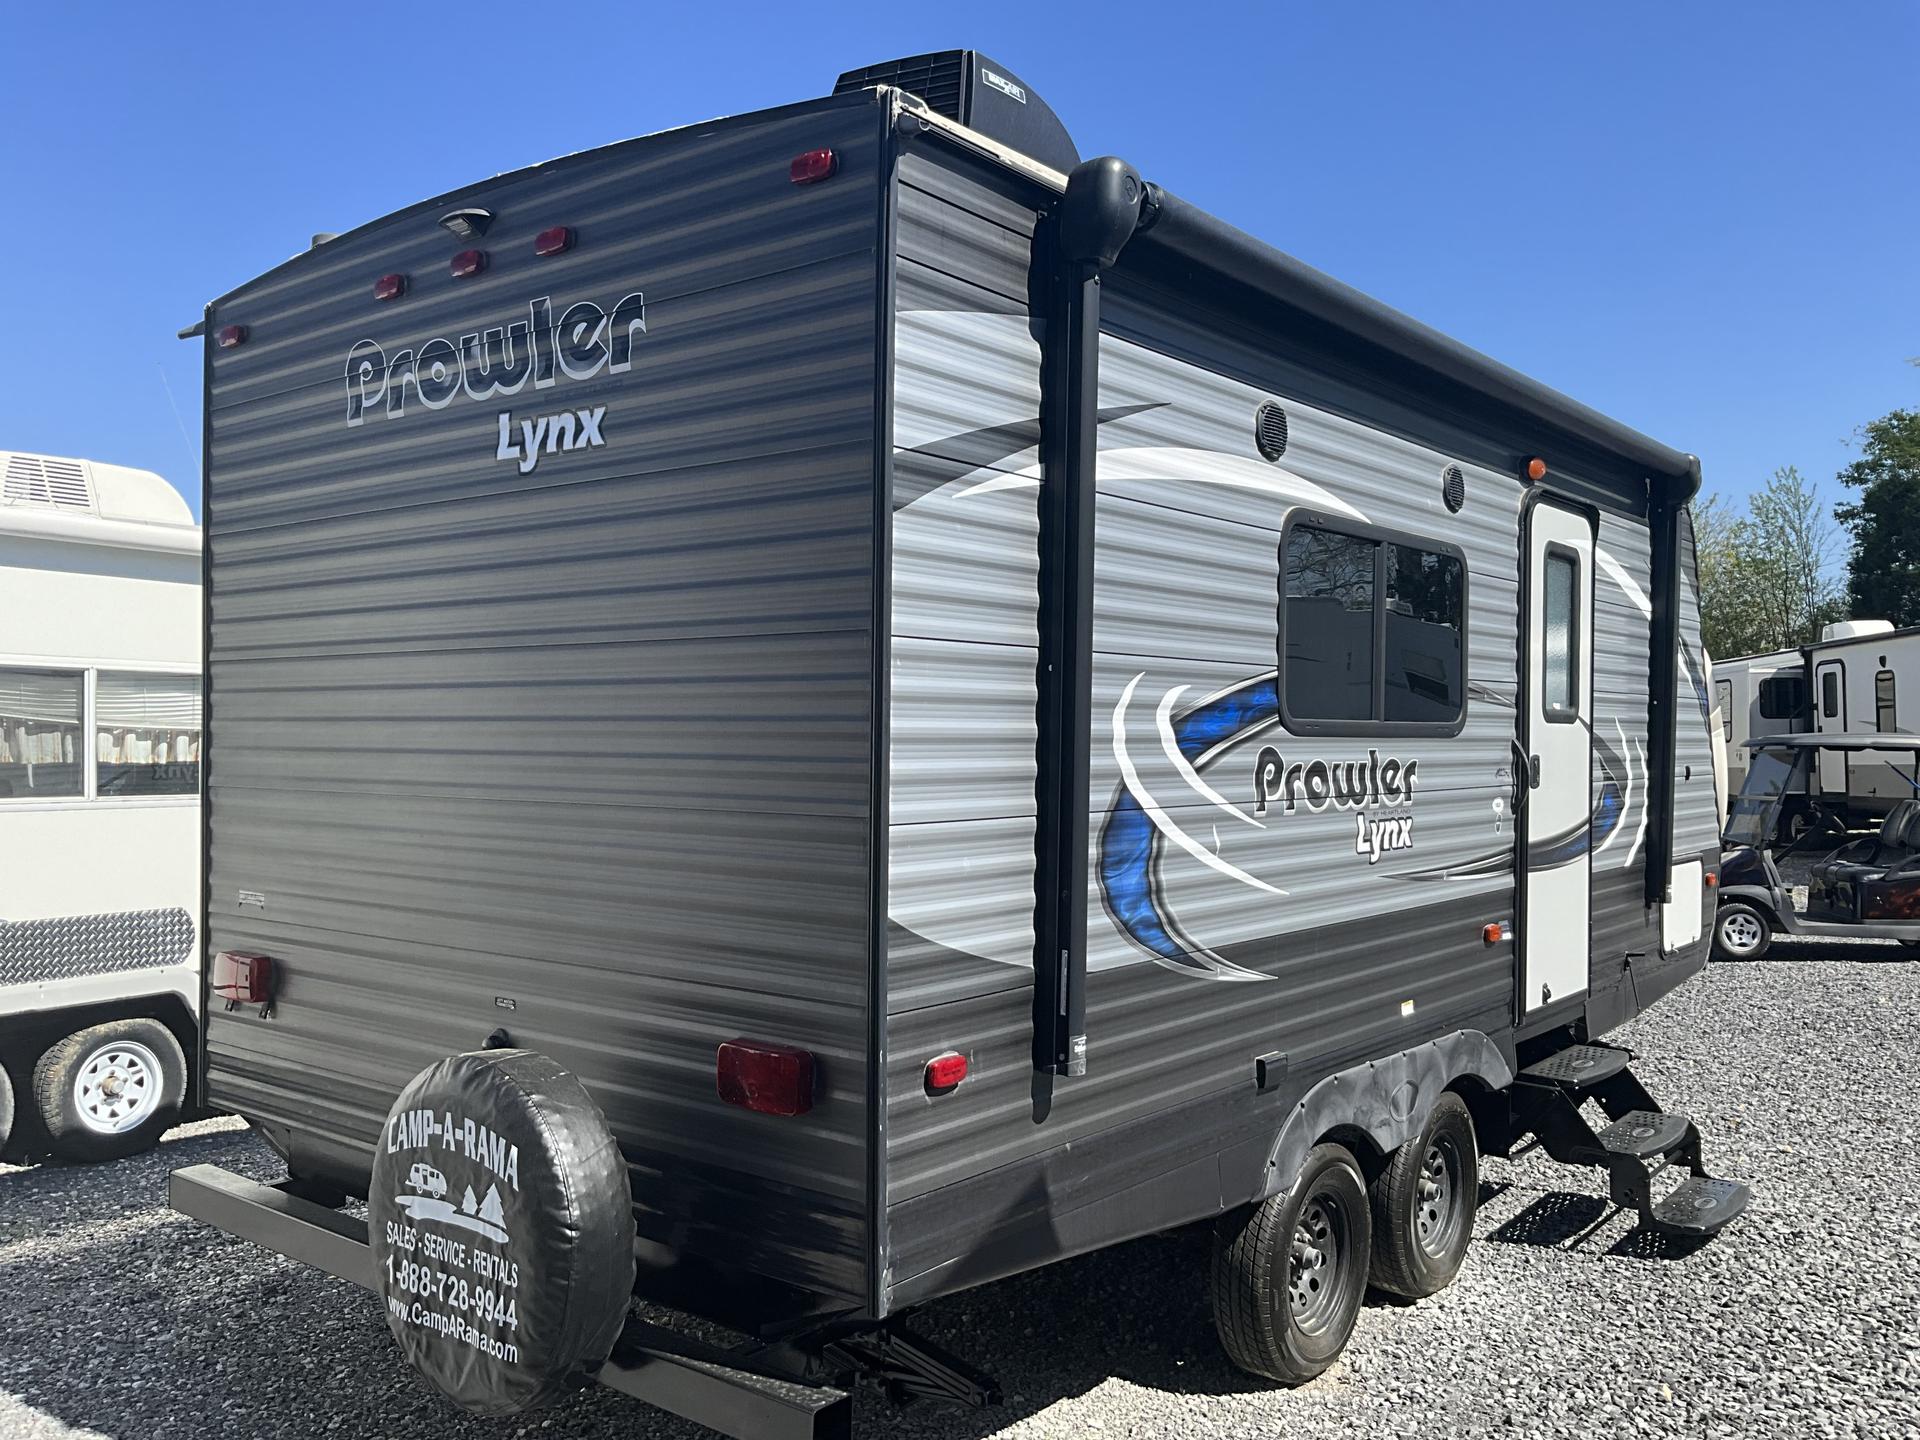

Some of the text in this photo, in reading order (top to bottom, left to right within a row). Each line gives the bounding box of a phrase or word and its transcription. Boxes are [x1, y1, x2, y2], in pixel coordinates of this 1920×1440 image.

[345, 292, 647, 427] Prowler
[495, 405, 607, 474] Lynx
[1253, 744, 1418, 817] Prowler
[1356, 812, 1413, 865] Lynx
[387, 1109, 519, 1192] CAMP-A-RAMA
[386, 1220, 417, 1251] SALES
[423, 1232, 465, 1268] SERVICE
[473, 1248, 519, 1288] RENTALS
[386, 1254, 518, 1331] 1-888-728-9944
[387, 1295, 518, 1364] www.CampARama.com
